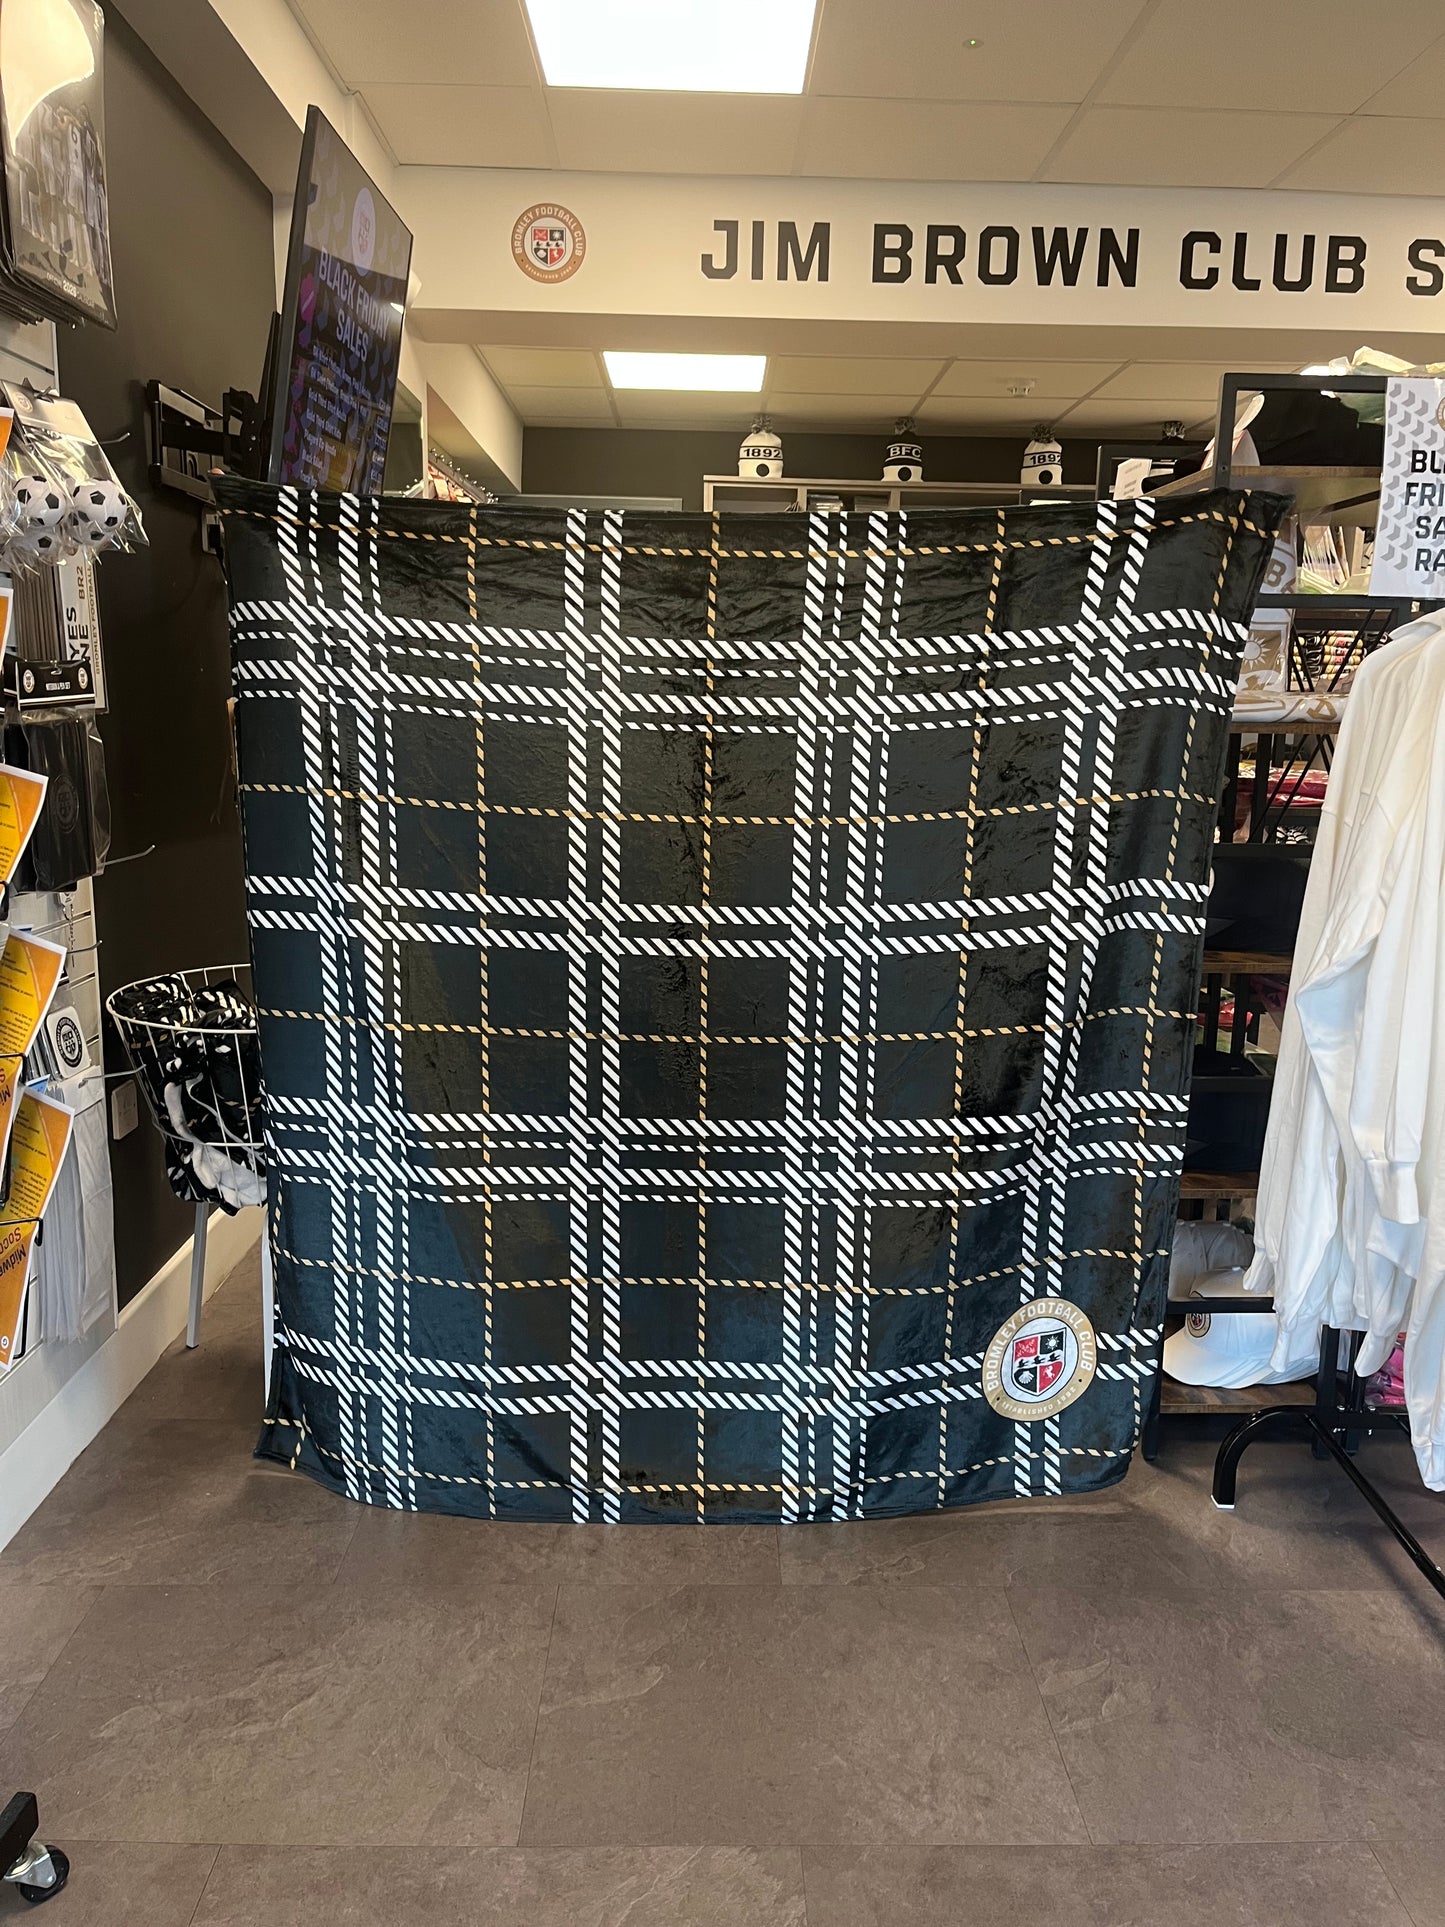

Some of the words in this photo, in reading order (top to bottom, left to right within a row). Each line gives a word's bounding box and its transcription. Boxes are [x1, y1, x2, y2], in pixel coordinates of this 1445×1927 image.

[514, 211, 534, 254] BROMLEY
[535, 206, 577, 230] FOOTBALL
[574, 231, 583, 257] CLUB
[701, 219, 831, 282] JIM
[872, 223, 1140, 287] BROWN
[1179, 230, 1367, 294] CLUB
[319, 246, 356, 310] BLACK
[356, 284, 389, 341] FRIDAY
[337, 308, 369, 362] SALES
[743, 447, 782, 459] 1892
[889, 445, 922, 458] BFC
[1411, 449, 1445, 474] BL
[76, 565, 86, 600] BR2
[86, 563, 97, 622] FOOTBALL
[90, 624, 100, 675] BROMLEY
[986, 1319, 1017, 1391] BROMLEY
[1019, 1302, 1084, 1329] FOOTBALL
[1079, 1330, 1094, 1372] CLUB
